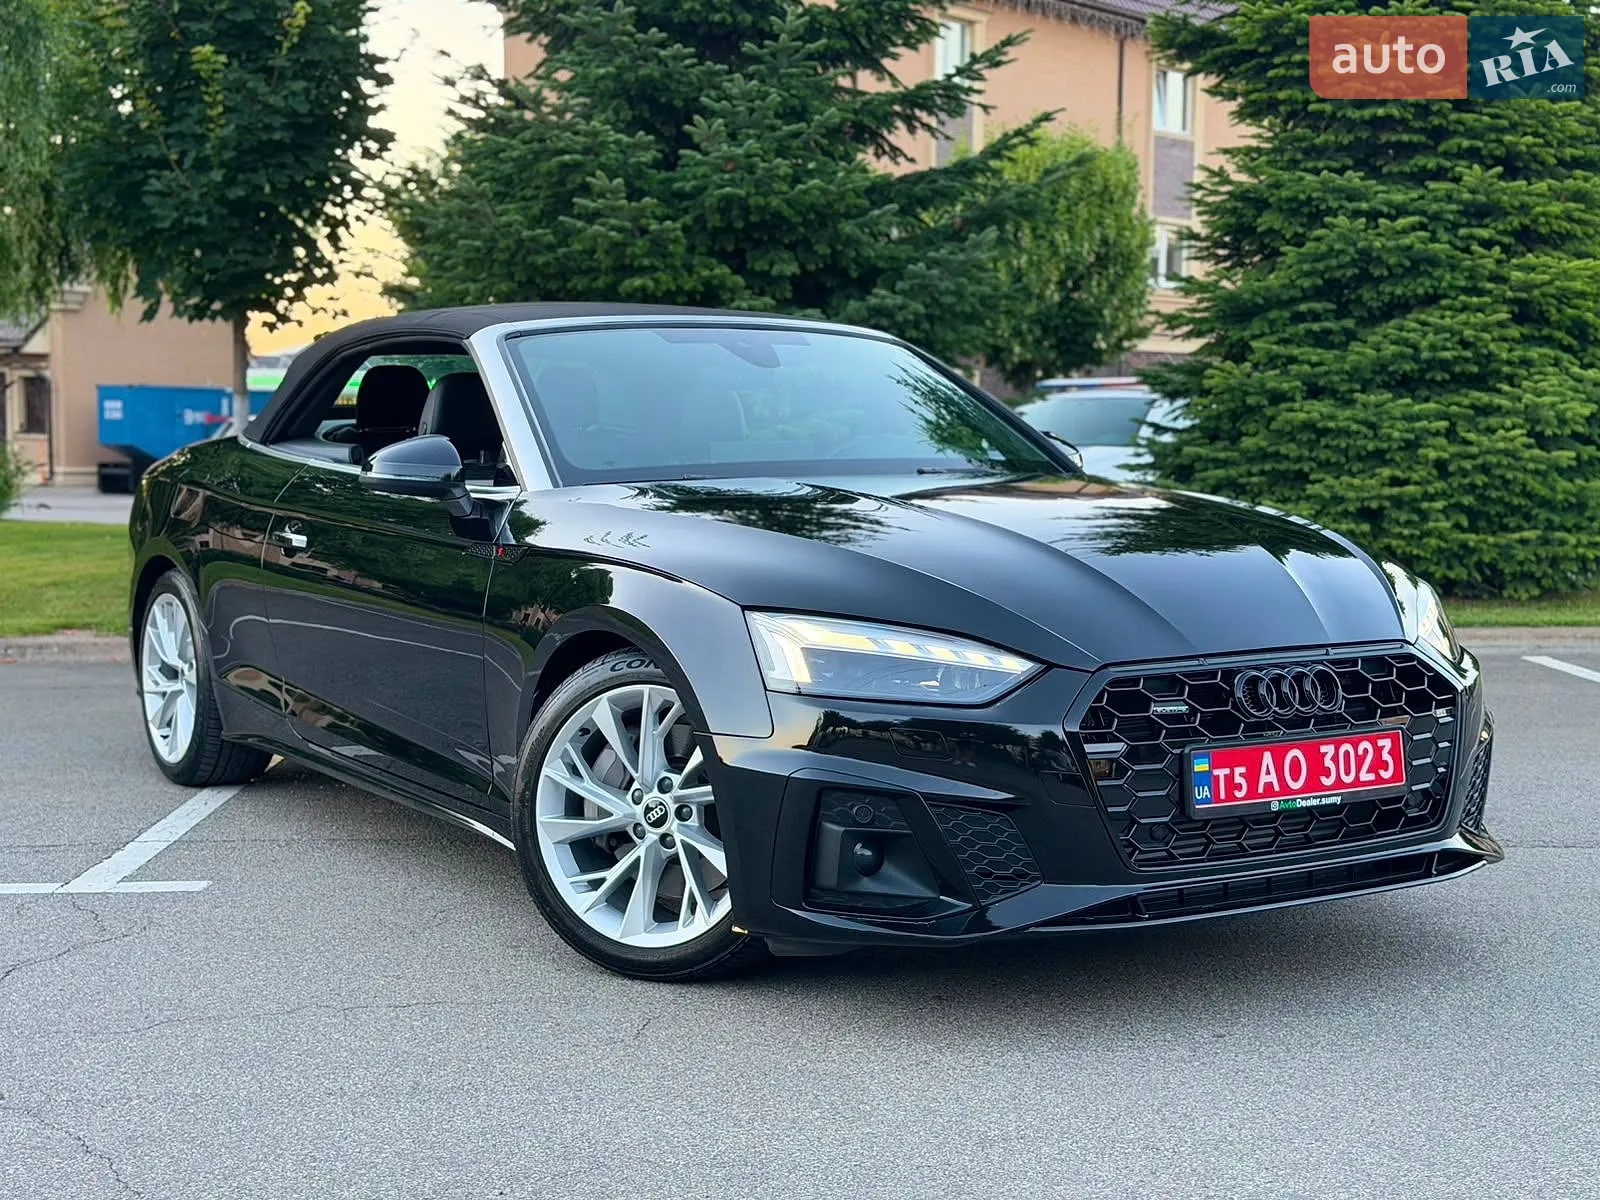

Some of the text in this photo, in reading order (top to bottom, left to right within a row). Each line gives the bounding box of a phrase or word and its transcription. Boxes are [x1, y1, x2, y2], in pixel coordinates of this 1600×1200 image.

[1212, 738, 1394, 800] T5 AO 3023
[1195, 785, 1211, 800] UA
